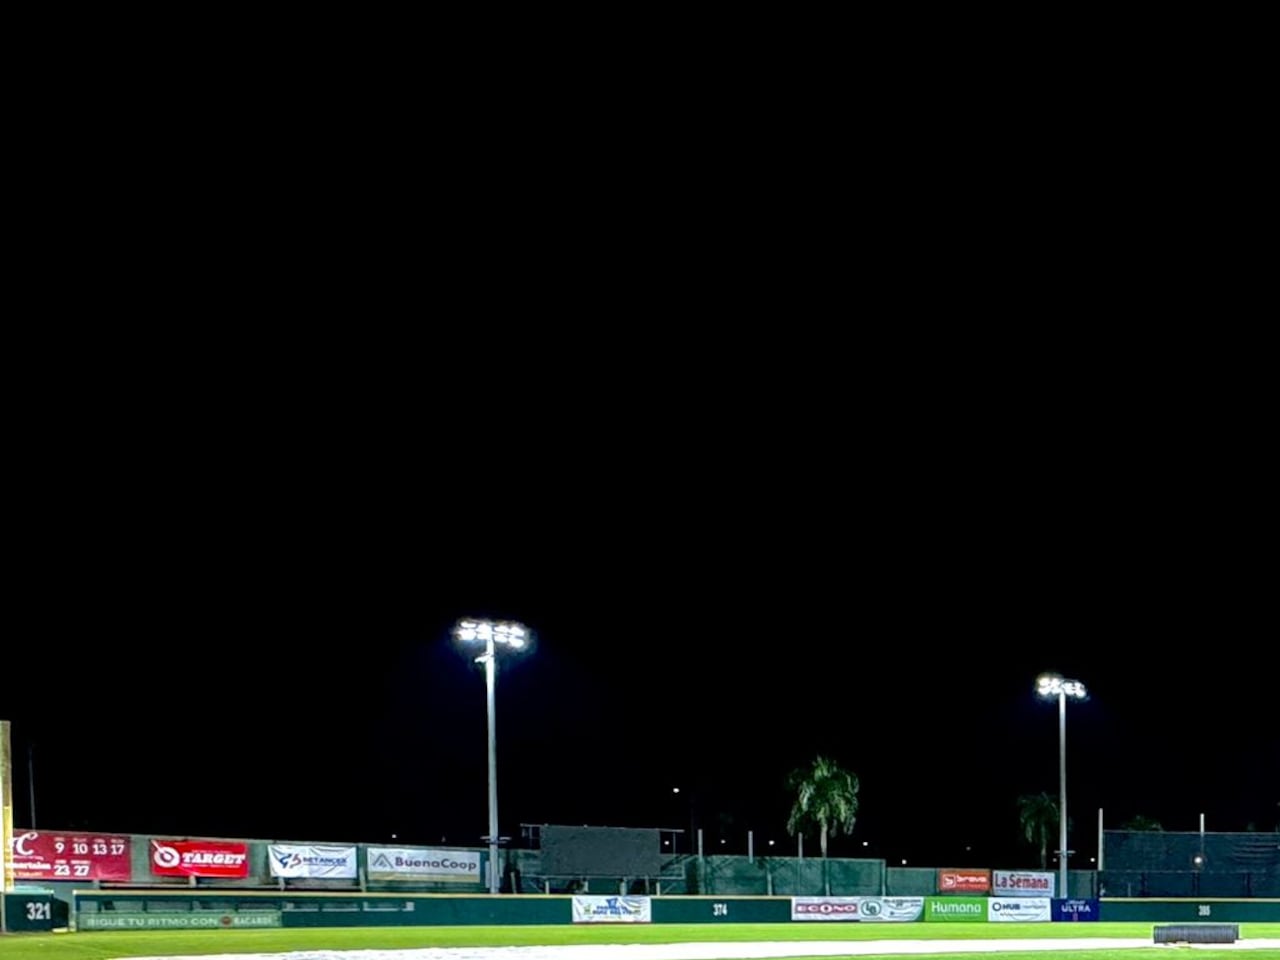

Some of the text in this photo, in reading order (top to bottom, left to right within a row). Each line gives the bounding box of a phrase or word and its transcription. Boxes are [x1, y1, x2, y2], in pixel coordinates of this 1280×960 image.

[55, 842, 125, 855] 9 10 13 17
[182, 853, 246, 865] TARGET
[395, 857, 477, 871] BuenaCoop
[54, 865, 70, 876] 23
[74, 865, 89, 876] 27
[995, 873, 1049, 889] La Semana
[26, 902, 51, 920] 321
[713, 903, 728, 916] 374
[797, 903, 857, 915] ECONO
[931, 902, 981, 912] Humana
[1061, 904, 1091, 912] ULTRA
[127, 918, 144, 926] TU
[148, 918, 188, 926] RITMO
[190, 918, 217, 926] CON
